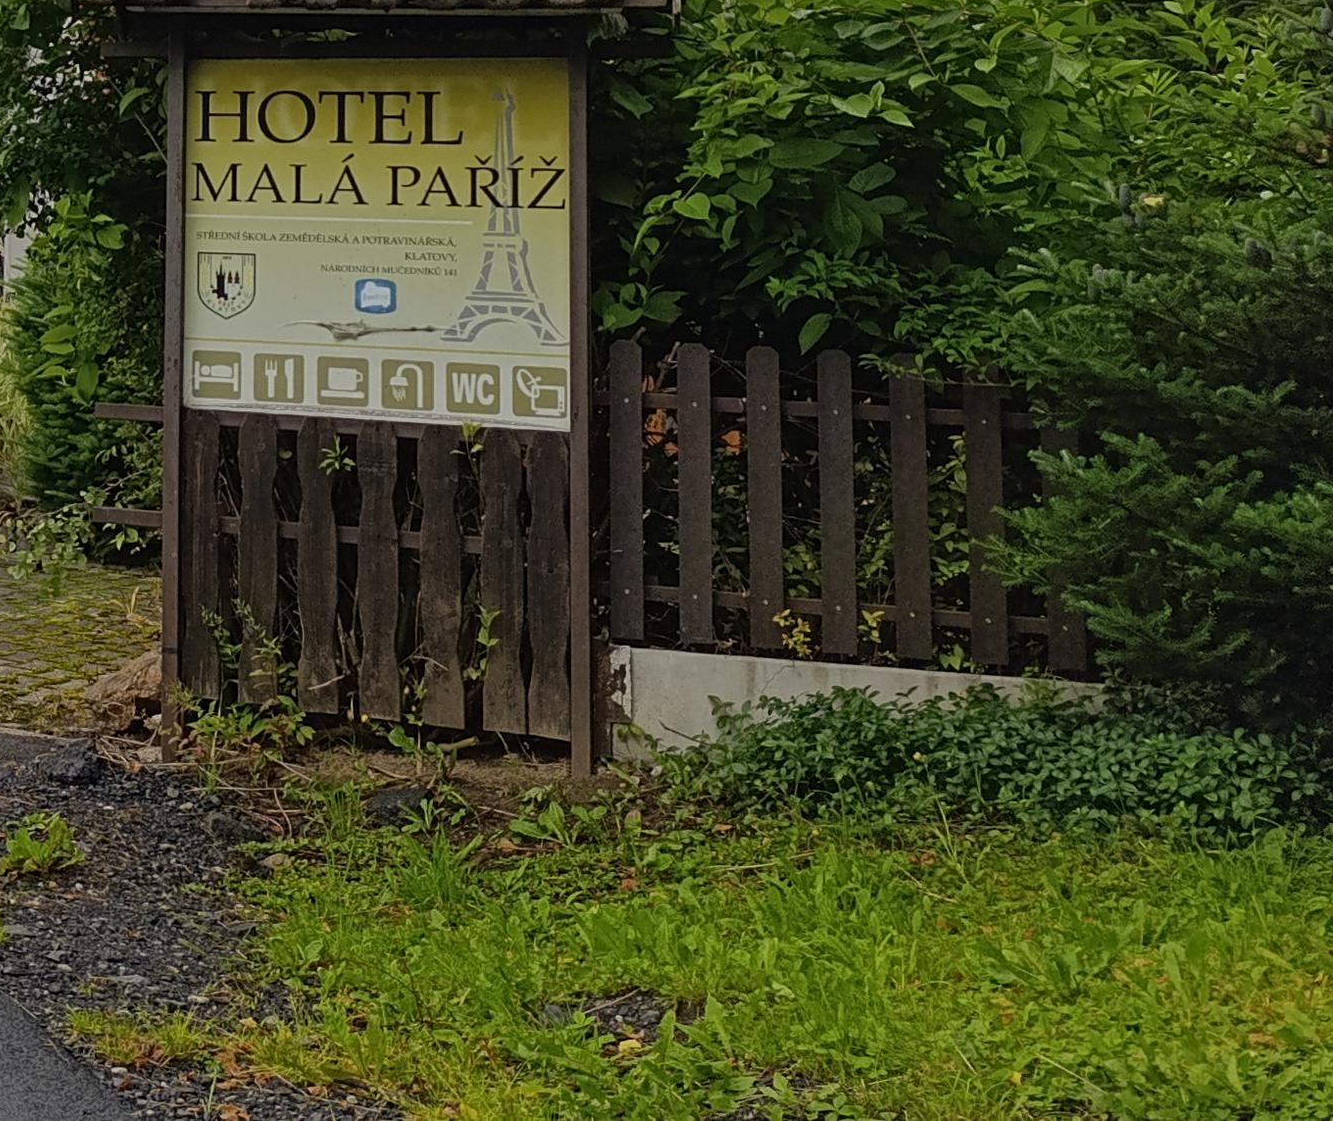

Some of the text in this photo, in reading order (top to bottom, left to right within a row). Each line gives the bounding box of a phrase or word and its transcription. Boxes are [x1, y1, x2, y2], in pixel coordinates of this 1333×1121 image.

[194, 90, 464, 145] HOTEL
[191, 153, 567, 210] MALÁ PAŘÍŽ
[196, 230, 240, 240] STŘEDNÍ
[242, 231, 277, 242] ŠKOLA
[279, 233, 349, 244] ZEMĚDĚLSKÁ
[405, 251, 458, 263] KLATOVY,
[320, 264, 458, 277] NÁRODNÍCH MUČEDNÍKŮ 141
[452, 372, 495, 405] WC
